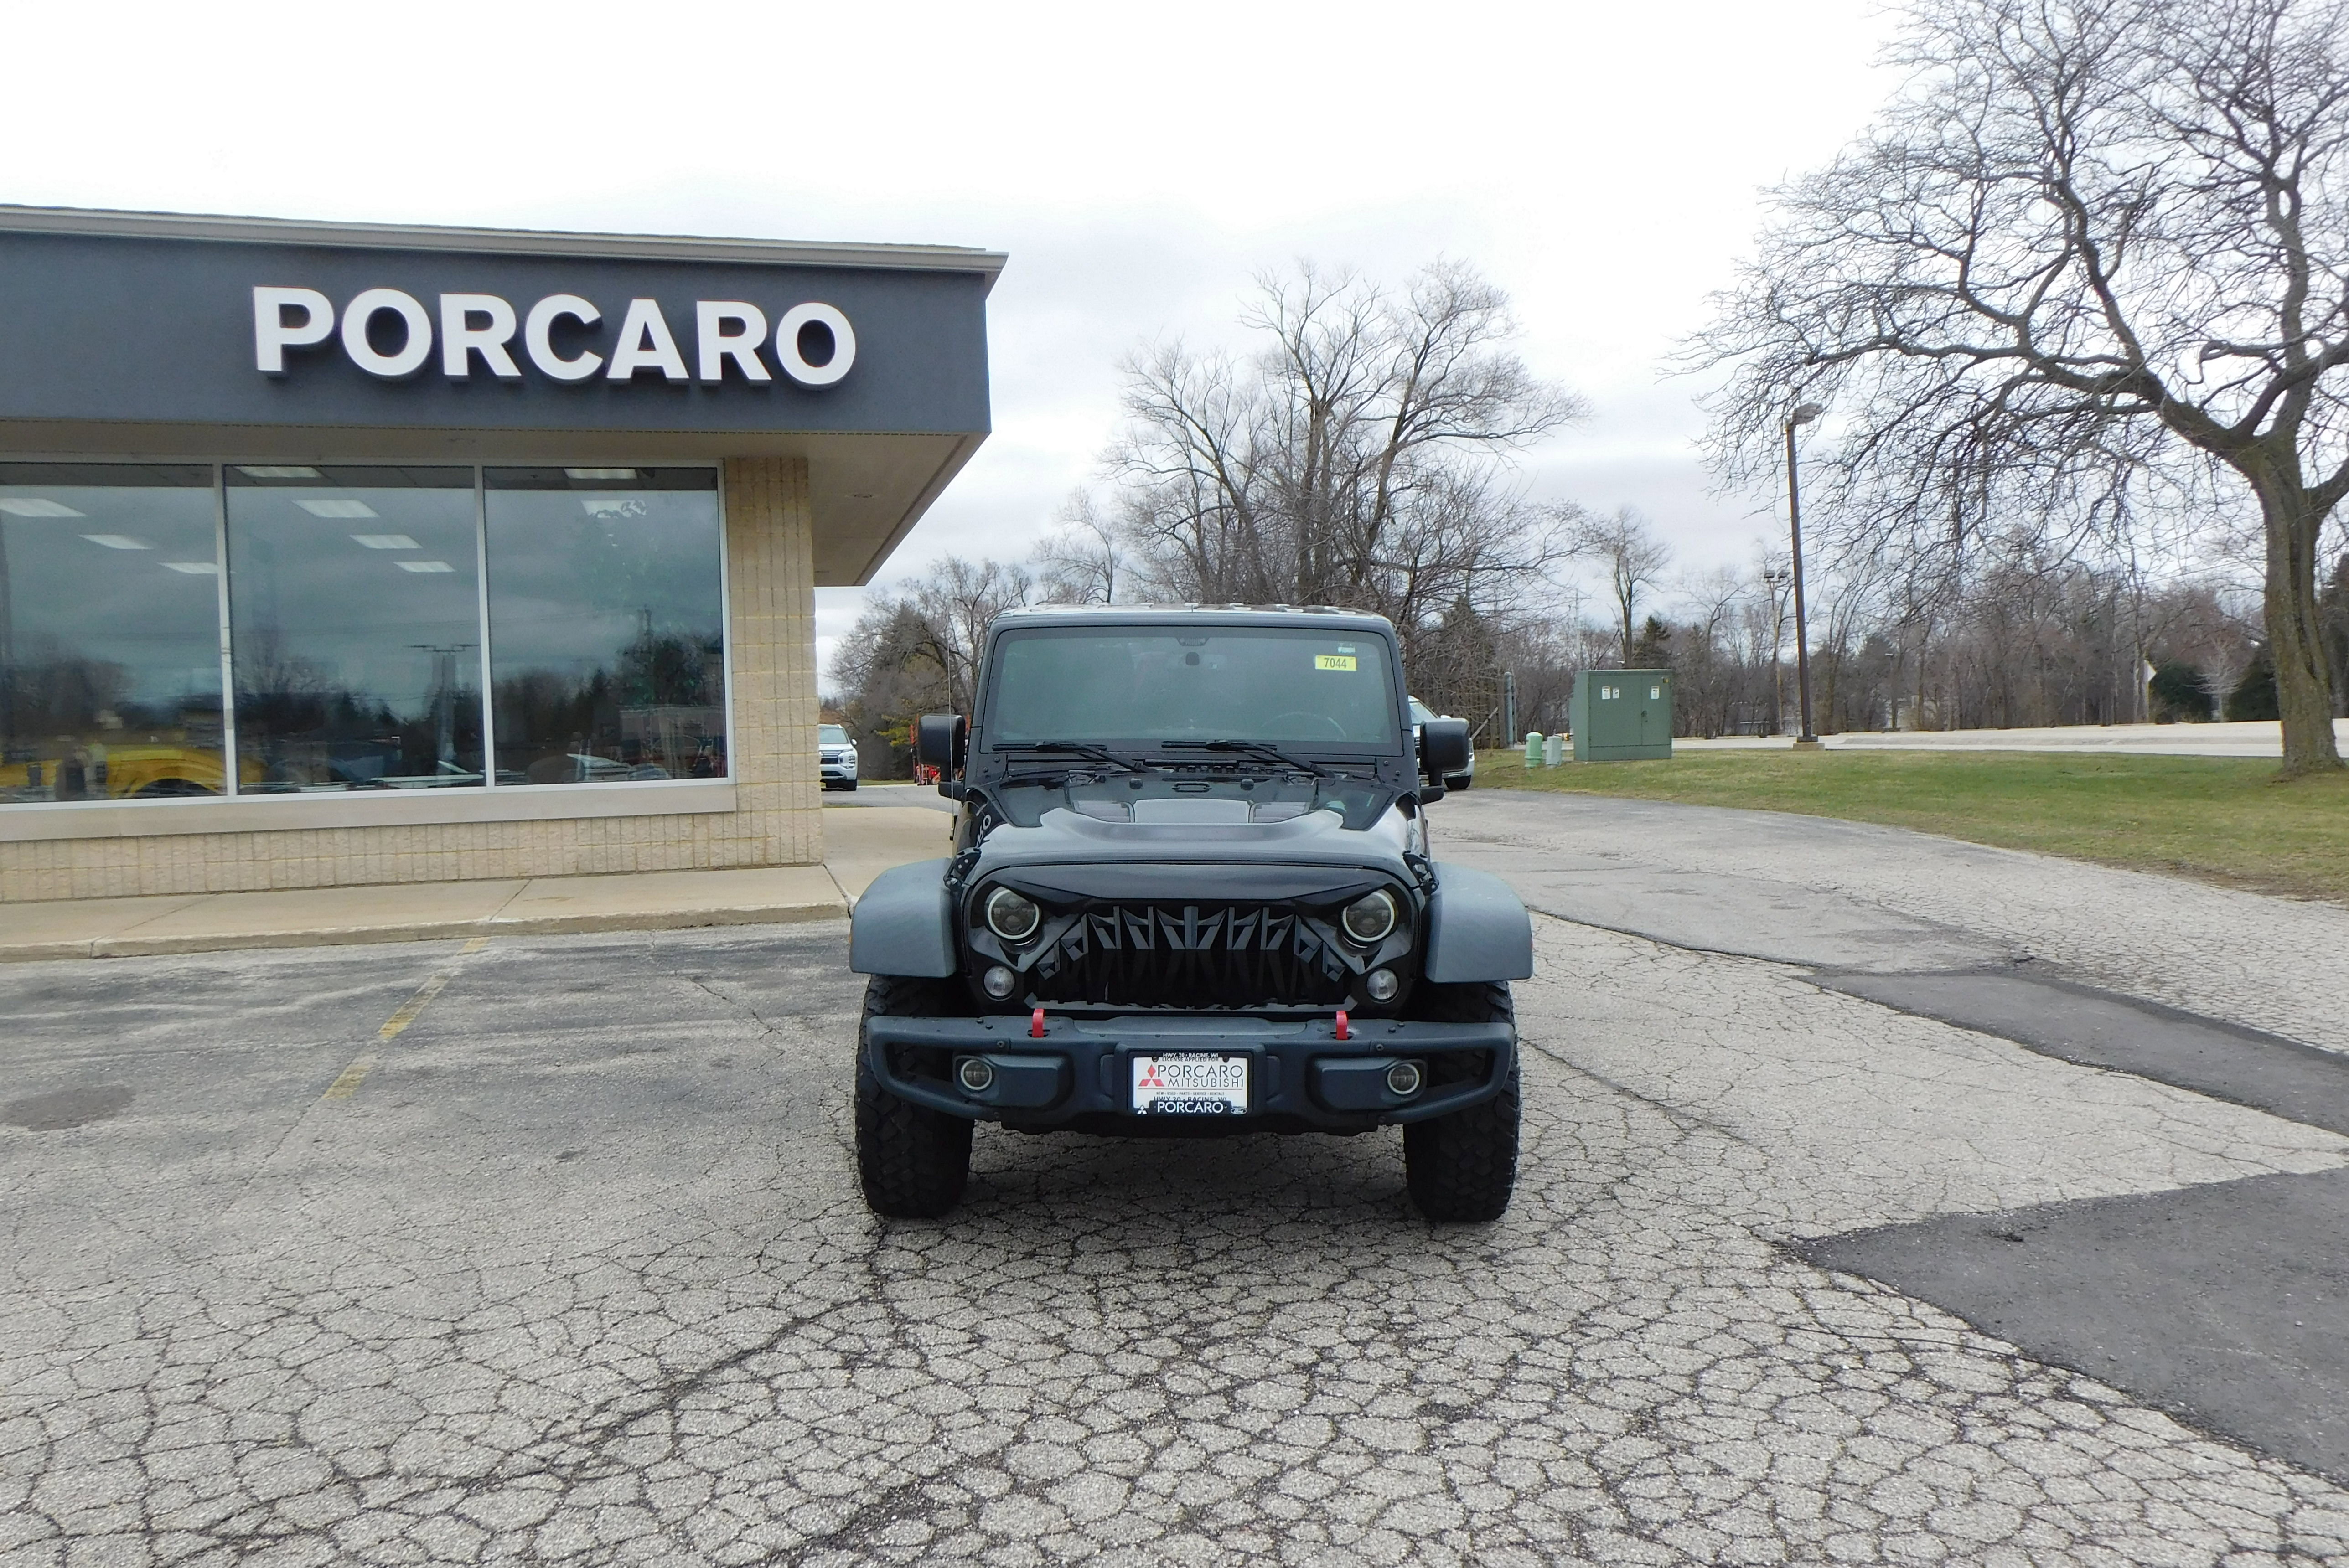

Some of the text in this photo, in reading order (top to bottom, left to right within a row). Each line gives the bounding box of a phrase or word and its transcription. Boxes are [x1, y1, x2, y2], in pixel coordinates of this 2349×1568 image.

[253, 286, 857, 387] PORCARO
[1324, 657, 1347, 668] 7044
[1158, 1065, 1243, 1078] PORCARO
[1168, 1078, 1243, 1087] MITSUBISHI
[1157, 1101, 1223, 1113] PORCARO
